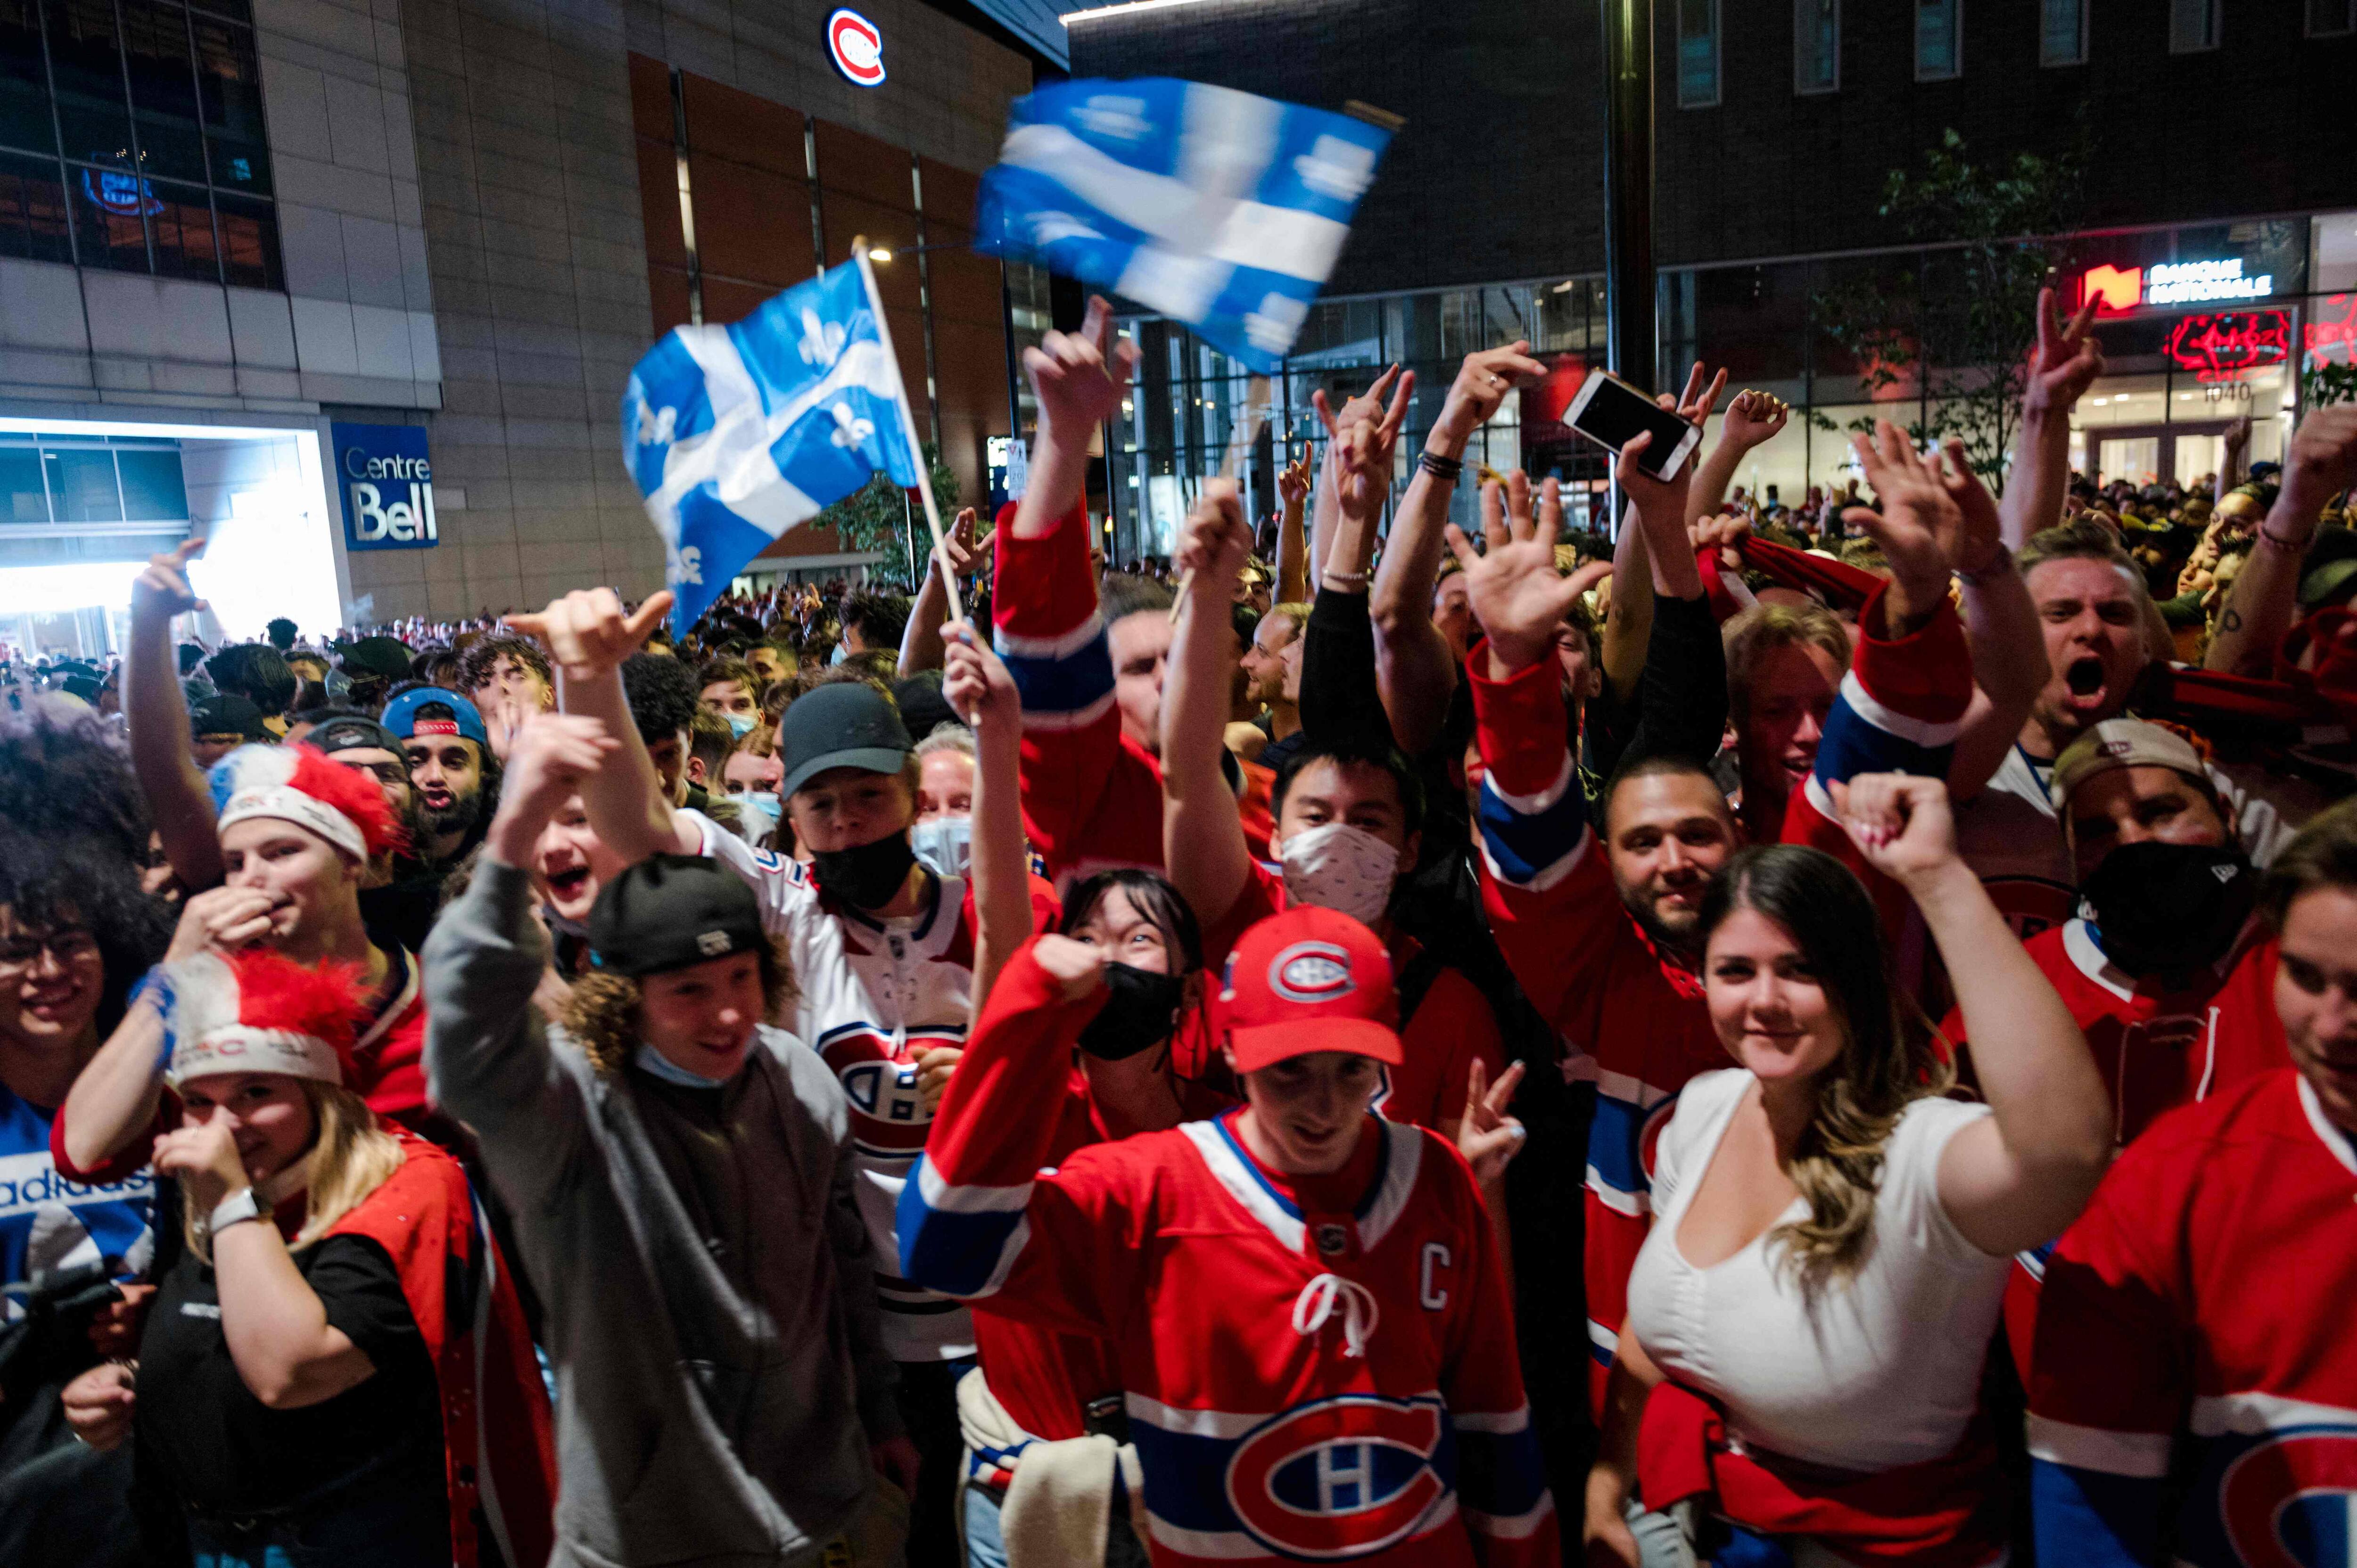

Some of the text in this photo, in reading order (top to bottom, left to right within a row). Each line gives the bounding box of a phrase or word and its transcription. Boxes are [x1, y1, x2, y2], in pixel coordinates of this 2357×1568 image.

[346, 446, 430, 480] Centre
[350, 482, 437, 542] Bell
[1421, 1242, 1451, 1310] C
